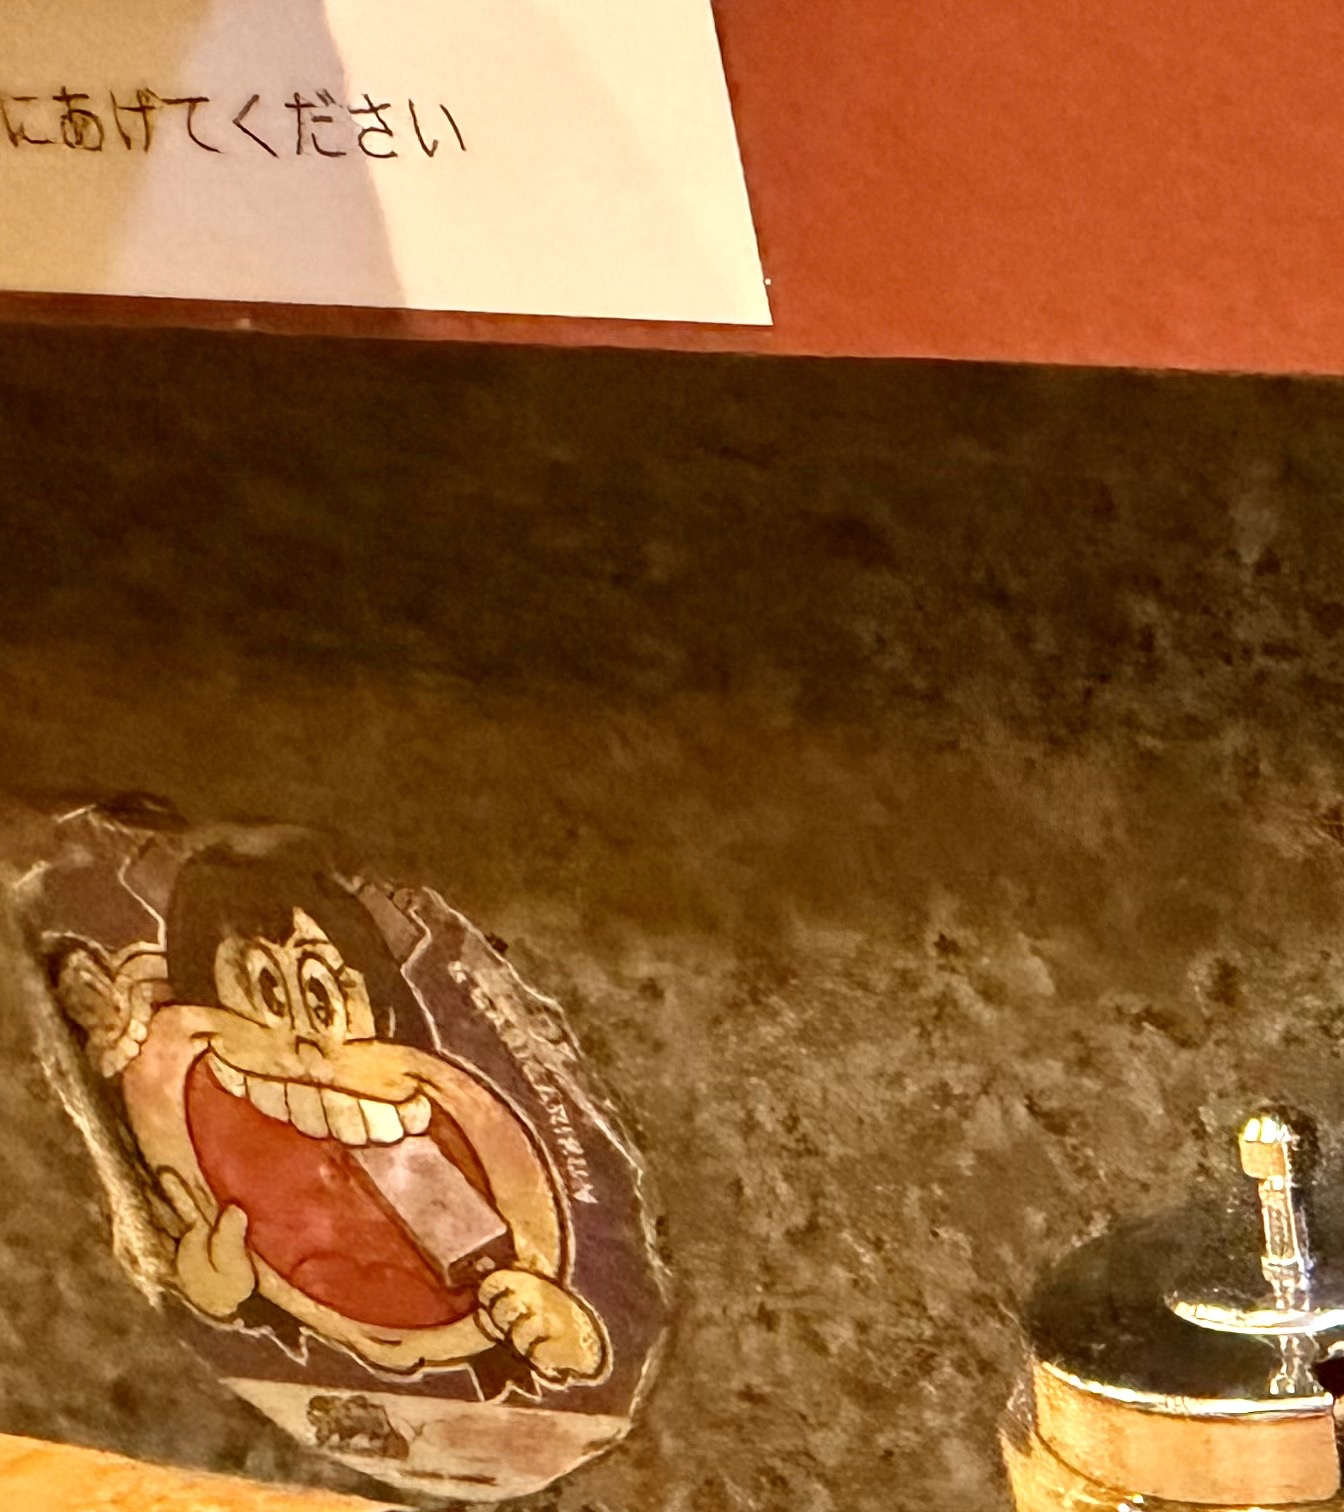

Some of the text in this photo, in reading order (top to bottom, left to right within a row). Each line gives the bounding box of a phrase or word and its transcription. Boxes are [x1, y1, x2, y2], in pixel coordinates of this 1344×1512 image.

[0, 86, 468, 159] にあげてください
